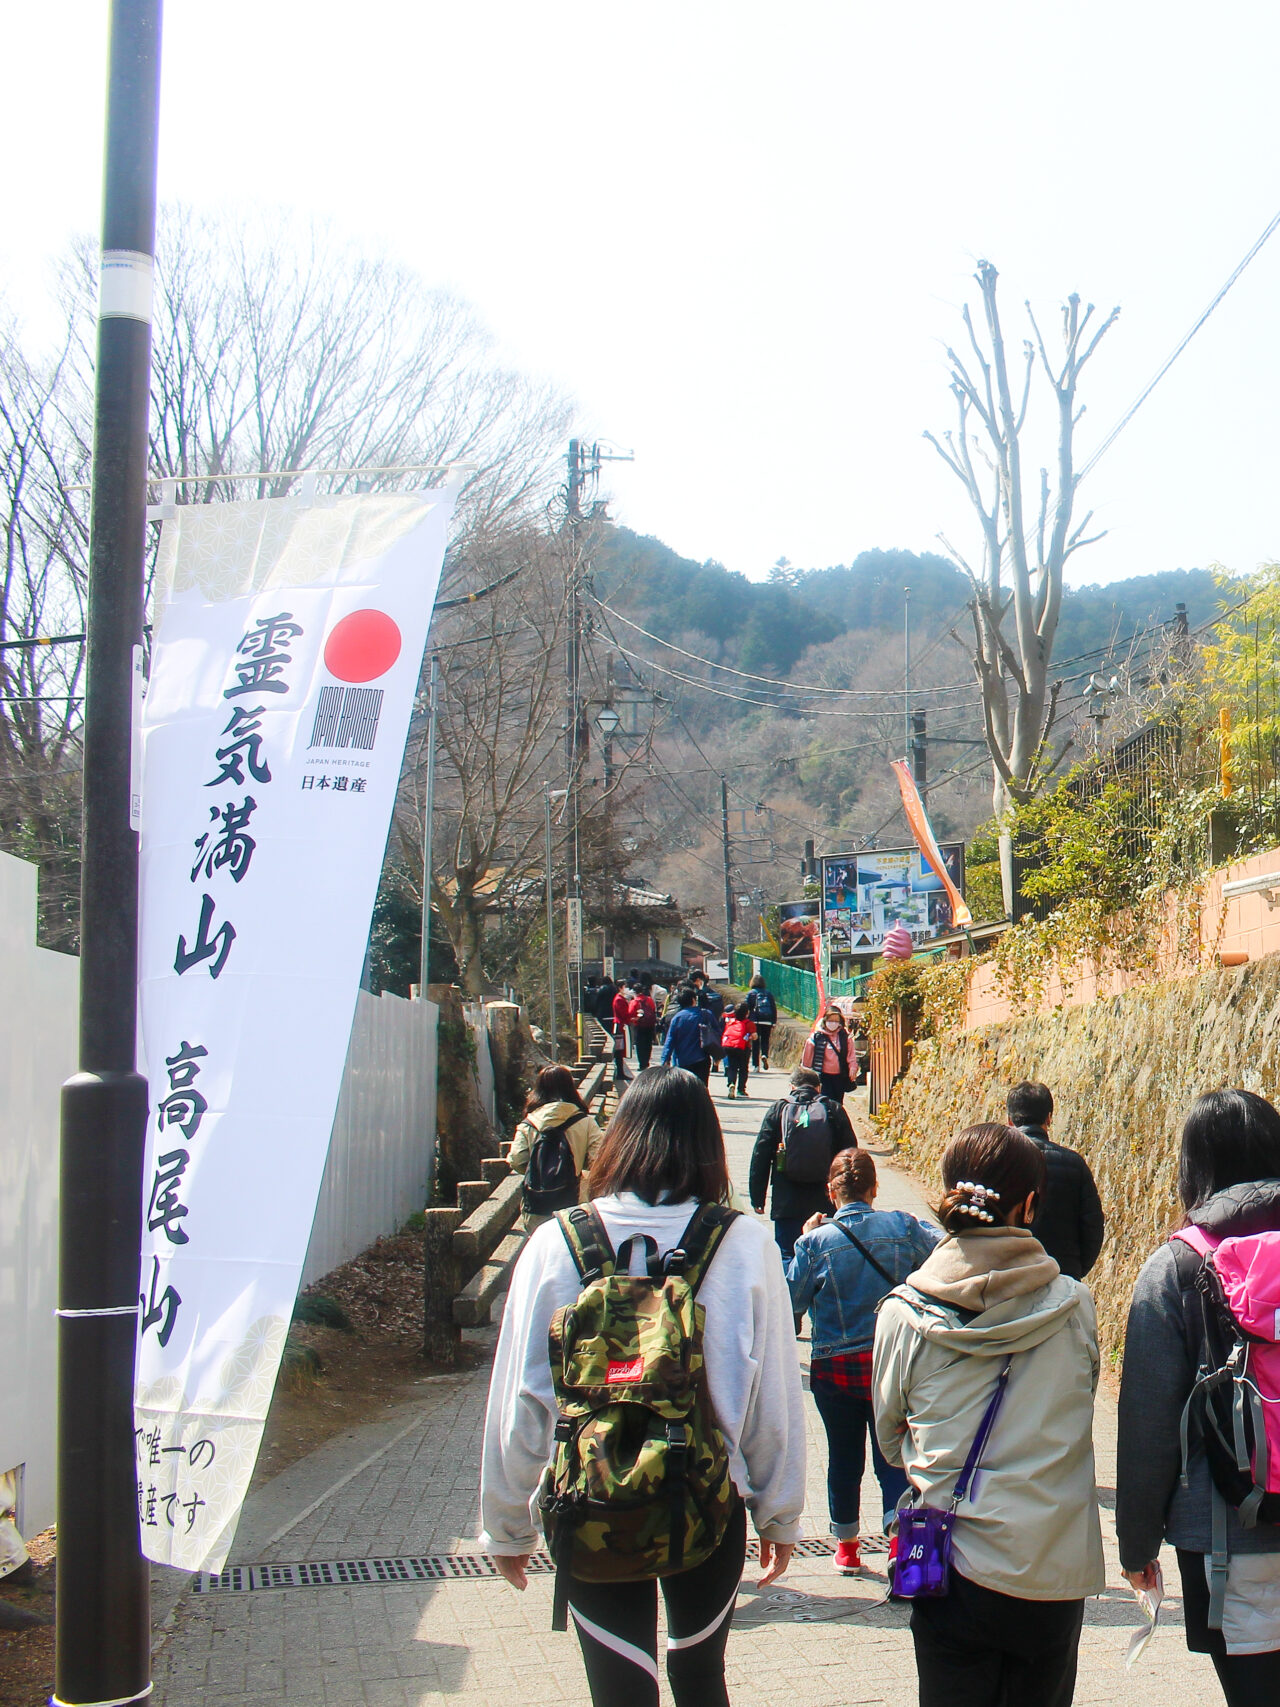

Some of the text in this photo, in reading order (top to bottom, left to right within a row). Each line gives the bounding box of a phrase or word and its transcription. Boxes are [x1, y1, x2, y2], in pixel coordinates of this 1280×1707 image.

[331, 759, 371, 768] HERITAGE
[301, 774, 367, 793] 日本遺産
[138, 611, 303, 1348] 霊気満山 高尾山
[908, 1544, 924, 1559] A6
